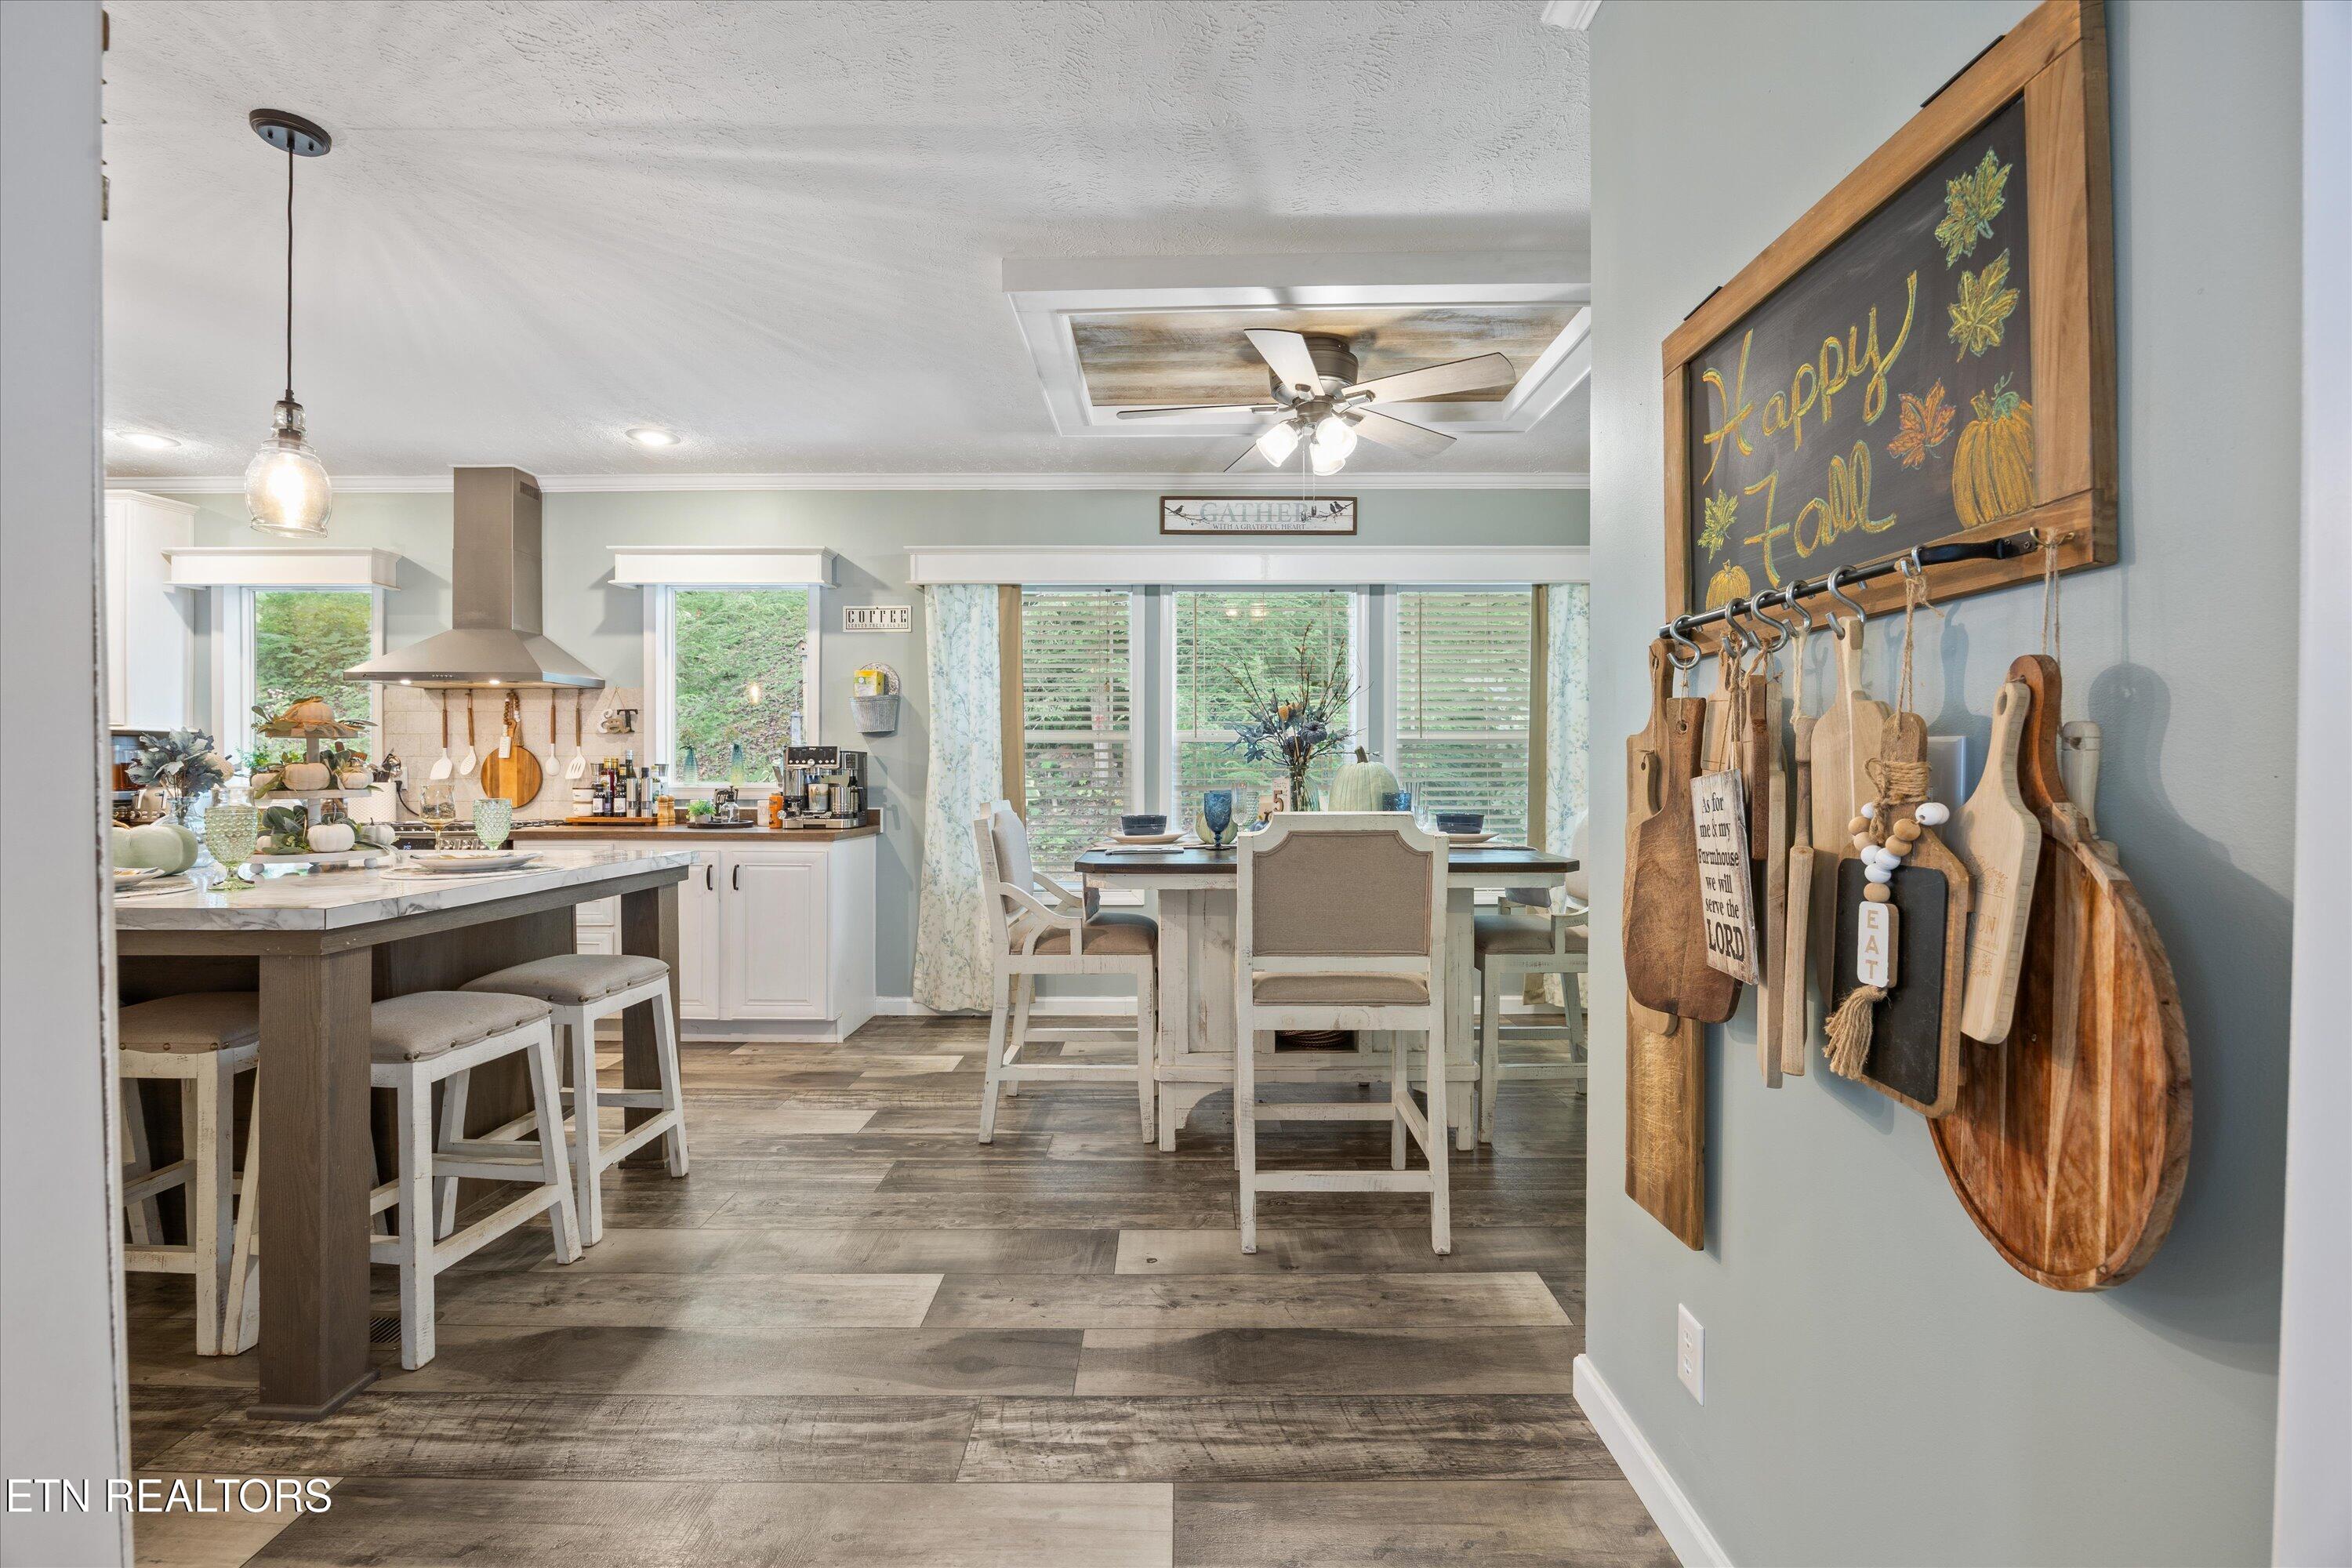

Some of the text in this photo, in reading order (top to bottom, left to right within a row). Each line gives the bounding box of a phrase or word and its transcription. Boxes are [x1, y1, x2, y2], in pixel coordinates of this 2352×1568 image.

[1703, 270, 1918, 485] Happy
[1744, 440, 1897, 587] Fall
[848, 610, 906, 623] COFFEE
[1273, 790, 1284, 812] 5
[1701, 792, 1724, 814] As for
[1700, 821, 1731, 843] me & my
[1697, 848, 1740, 868] Farmhouse
[1705, 873, 1733, 894] we will
[1705, 897, 1740, 920] serve the
[1706, 918, 1745, 963] LORD
[1864, 909, 1880, 980] EAT
